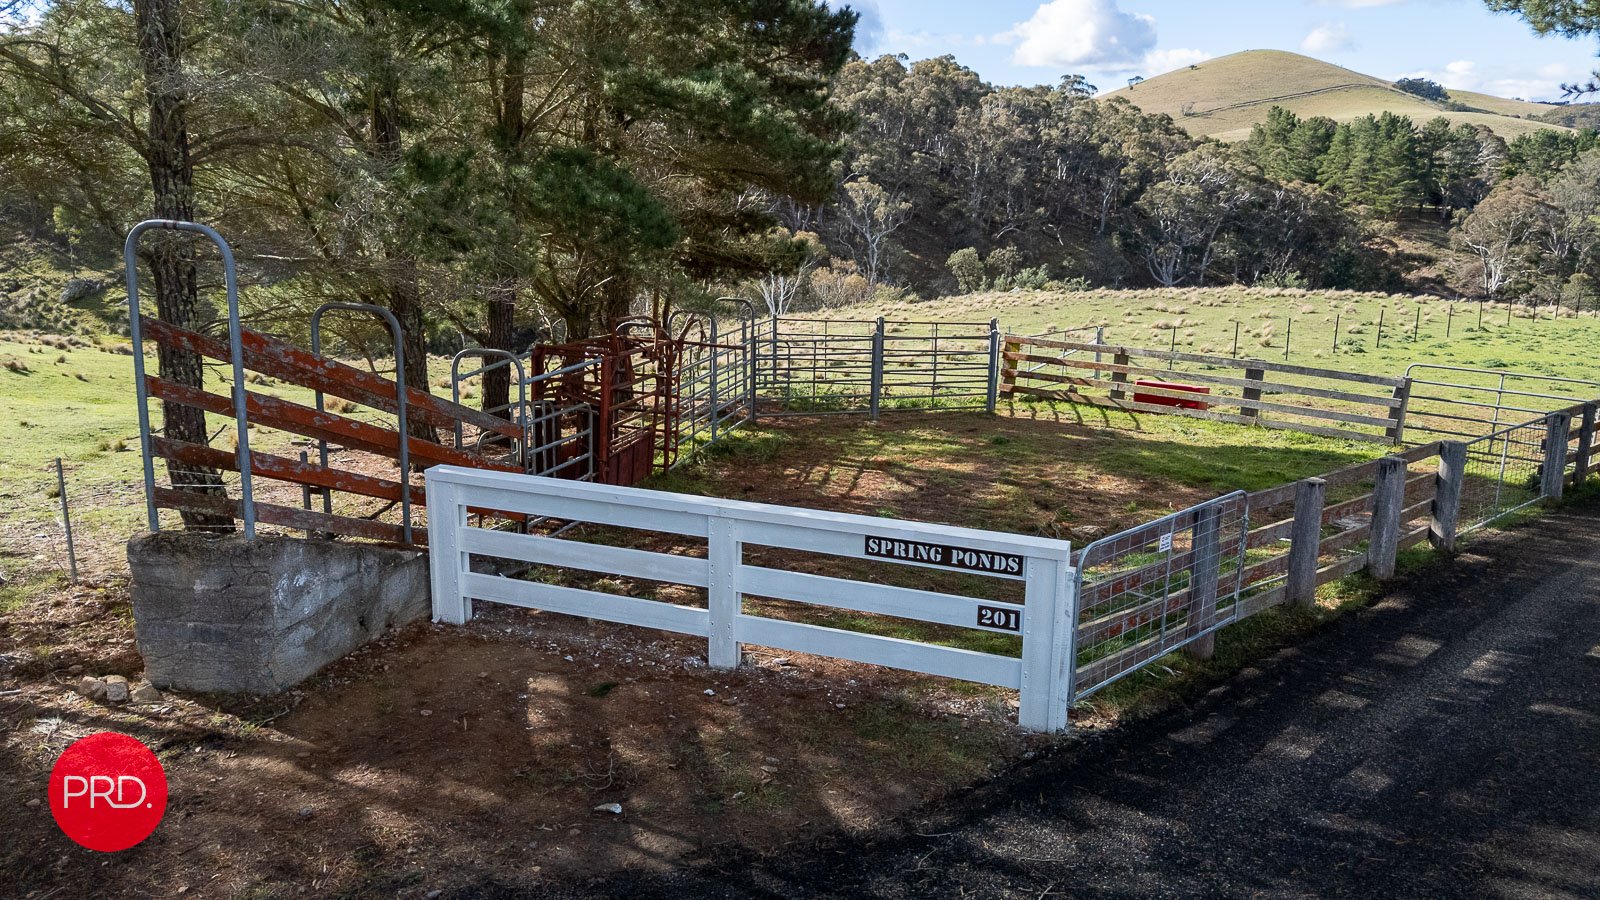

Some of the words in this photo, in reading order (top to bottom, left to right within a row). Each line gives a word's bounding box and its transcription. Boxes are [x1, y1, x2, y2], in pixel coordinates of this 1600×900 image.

[868, 538, 942, 562] SPRING
[951, 549, 1019, 573] PONDS
[981, 608, 1017, 629] 201
